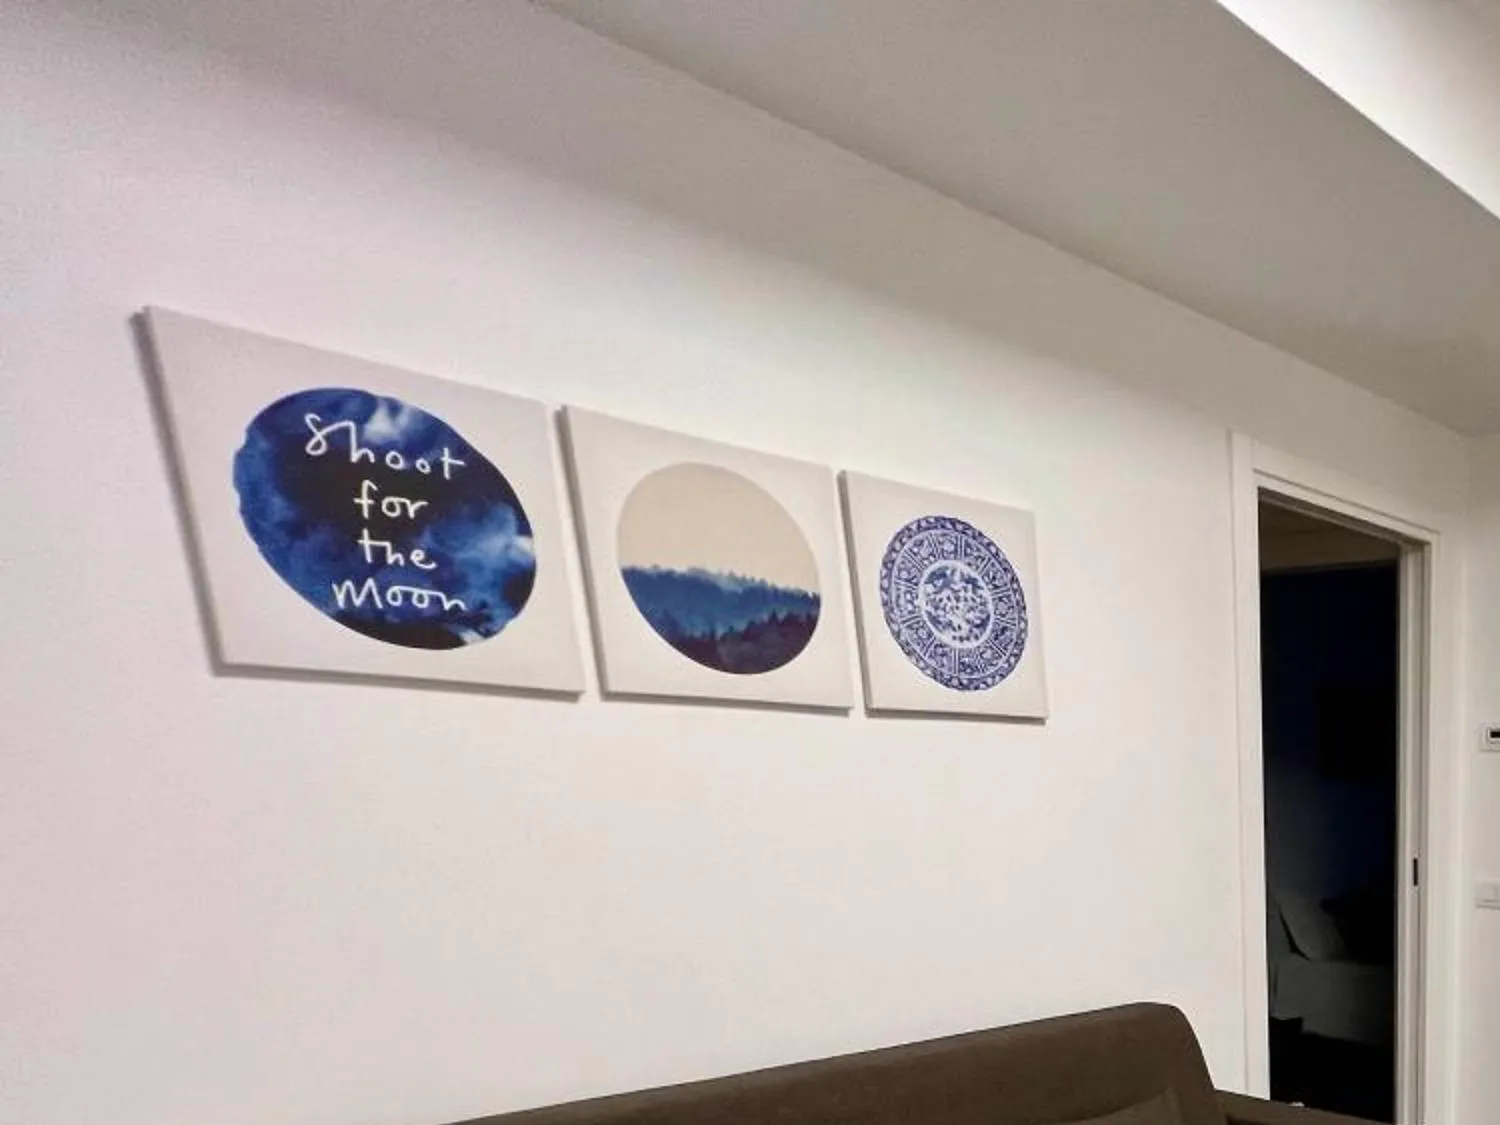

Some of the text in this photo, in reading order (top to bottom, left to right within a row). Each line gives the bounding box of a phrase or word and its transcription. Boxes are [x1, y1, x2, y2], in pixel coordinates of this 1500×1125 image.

[304, 413, 465, 480] Shoot
[353, 479, 429, 519] for
[358, 529, 438, 570] the
